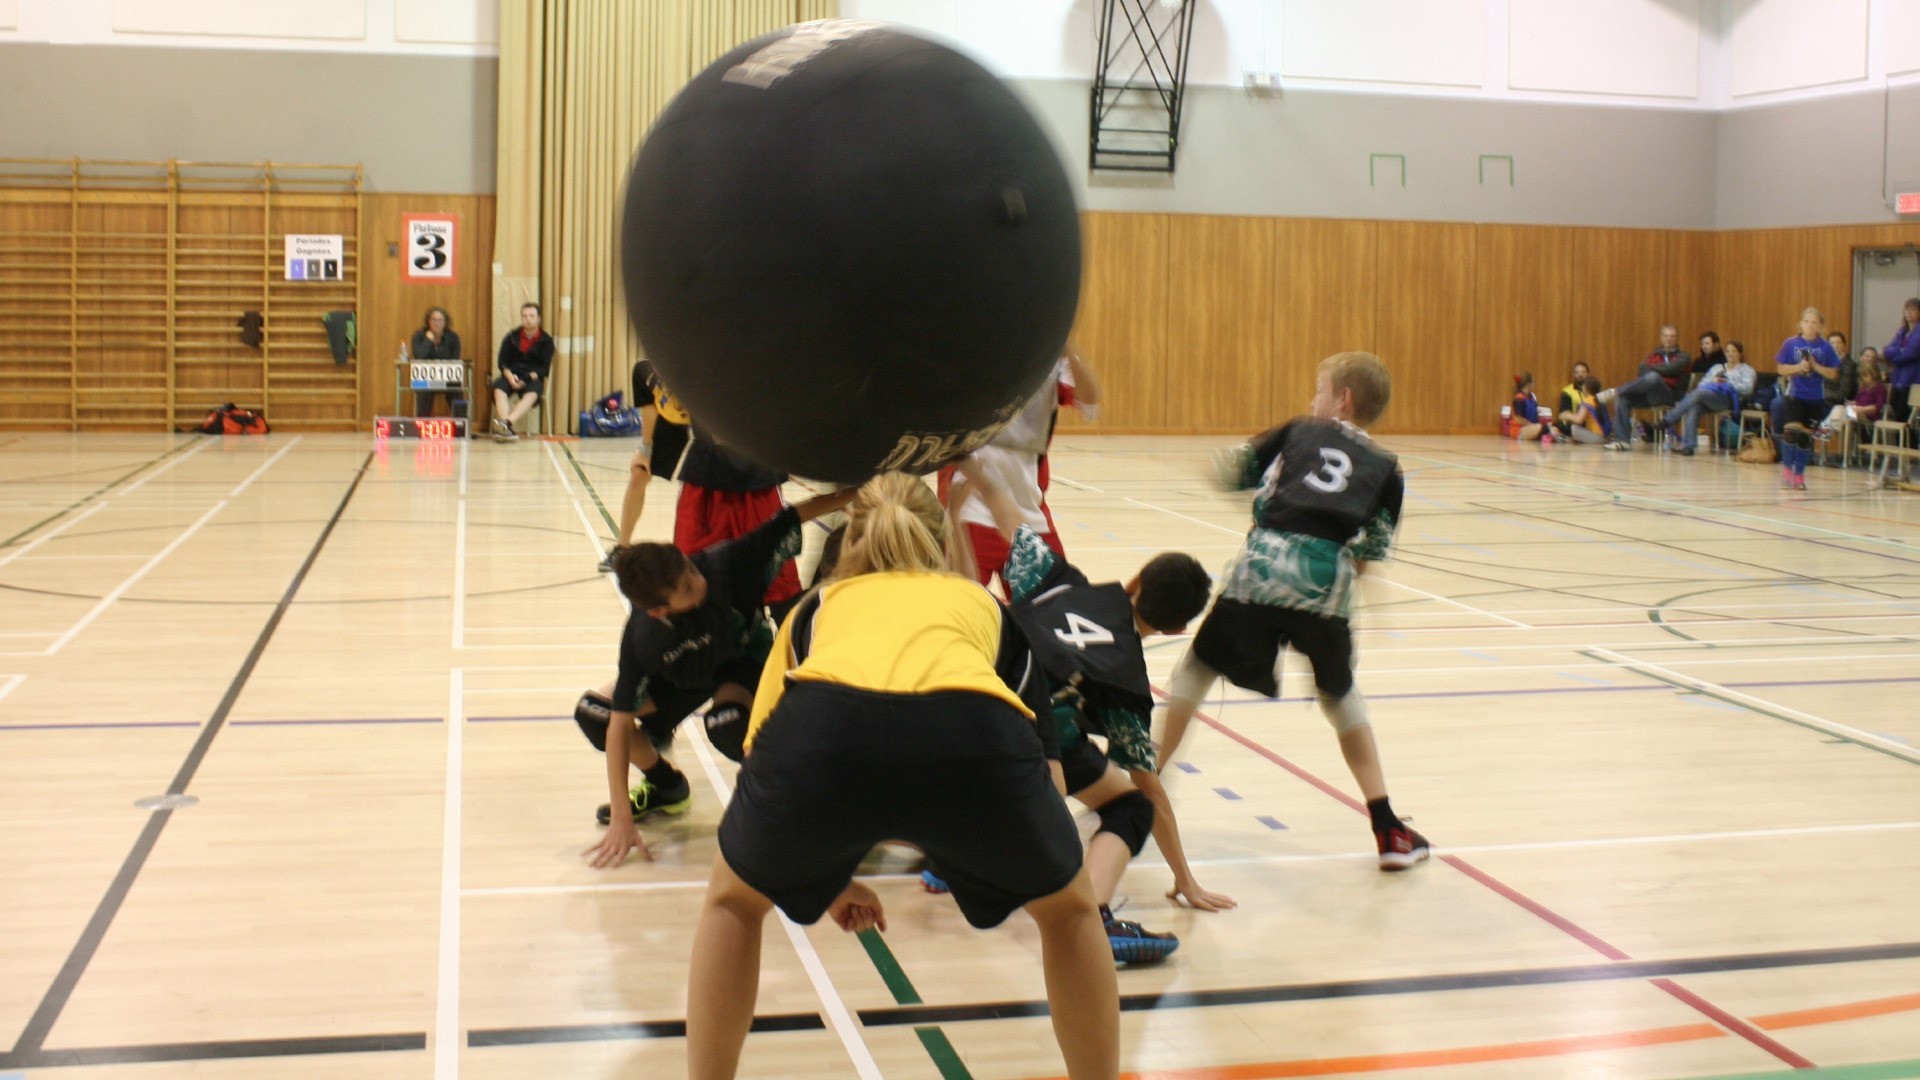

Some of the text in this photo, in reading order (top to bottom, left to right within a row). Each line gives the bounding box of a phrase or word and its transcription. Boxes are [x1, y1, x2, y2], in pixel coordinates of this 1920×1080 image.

[413, 233, 447, 271] 3
[1302, 446, 1354, 493] 3
[1053, 612, 1115, 650] 4
